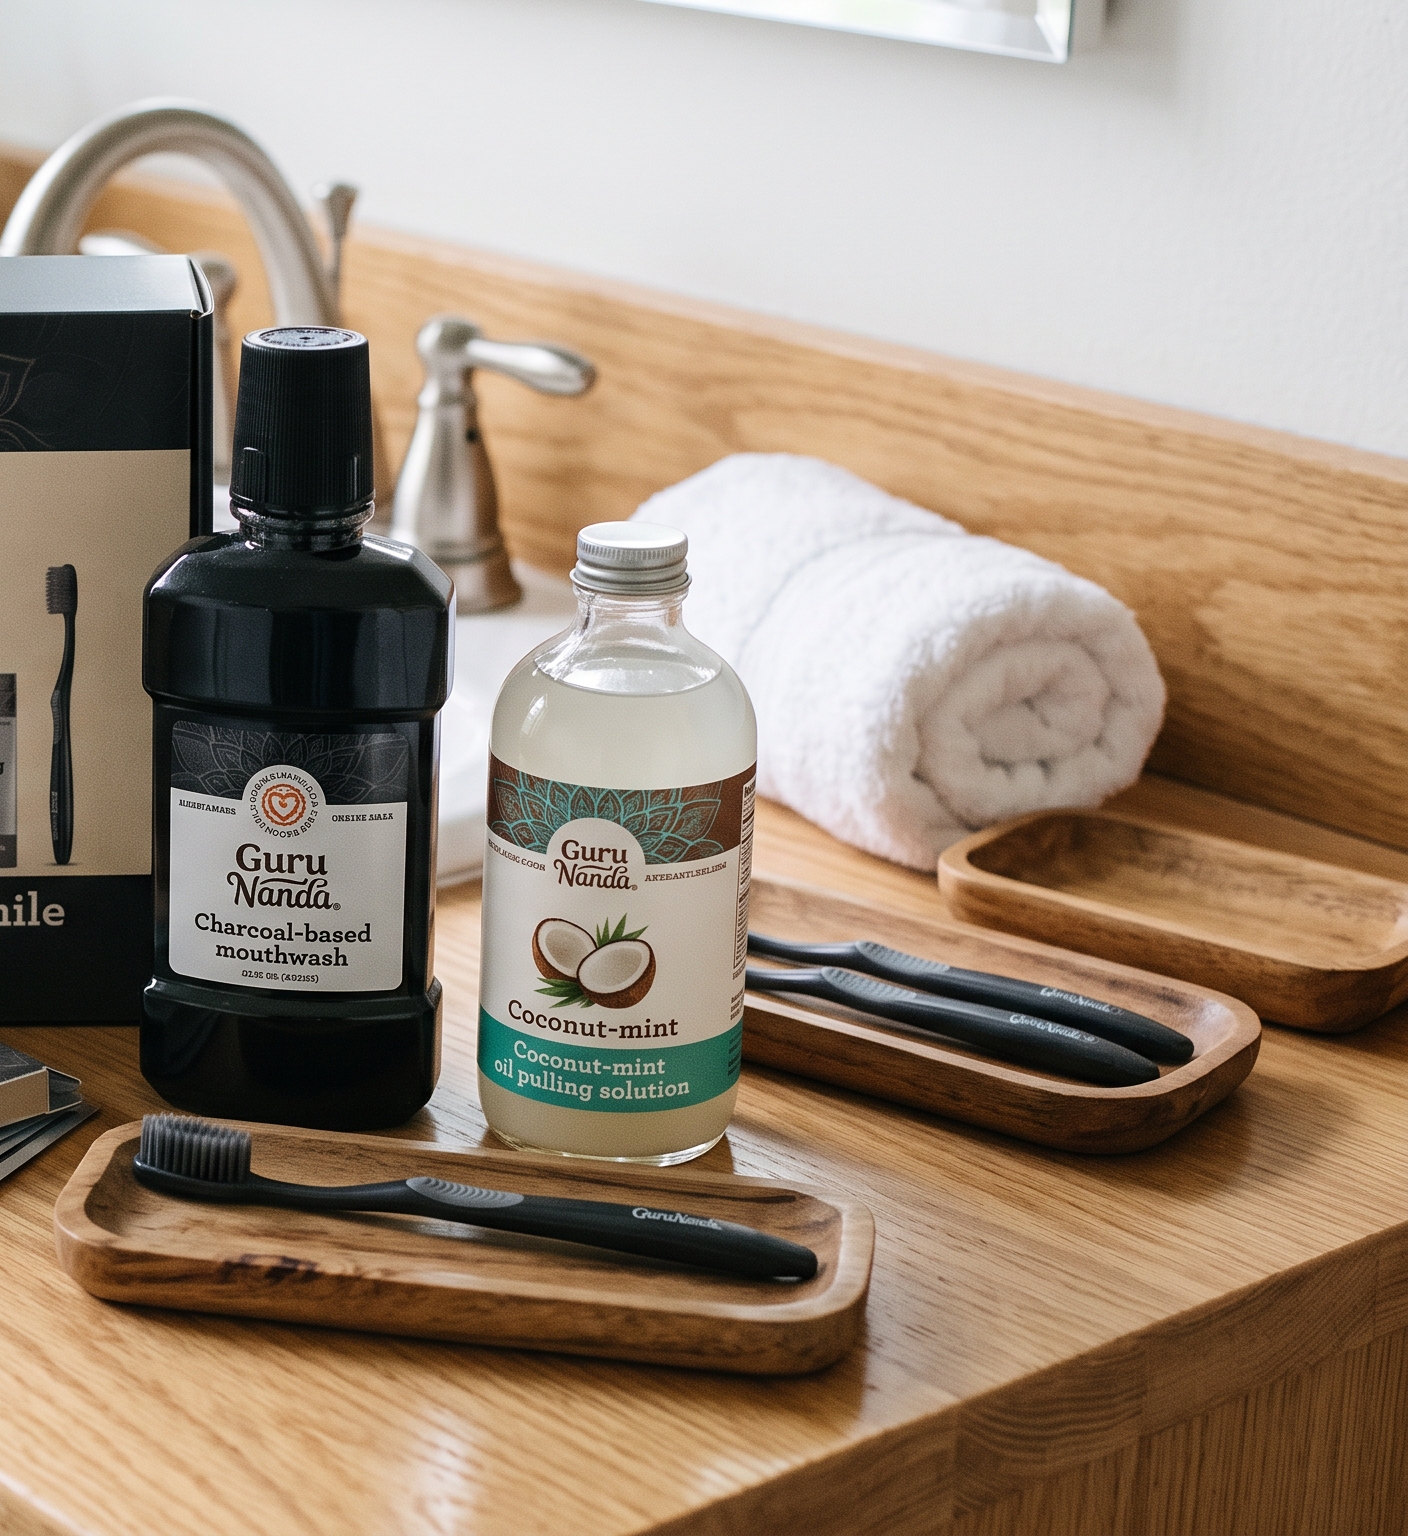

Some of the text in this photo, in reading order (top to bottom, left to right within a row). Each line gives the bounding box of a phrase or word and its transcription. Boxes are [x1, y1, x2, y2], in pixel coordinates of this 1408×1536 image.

[235, 843, 328, 875] Guru
[561, 839, 629, 864] Guru
[226, 871, 335, 910] Nanda
[553, 858, 633, 891] Nanda
[194, 912, 372, 943] Charcoal-based
[215, 944, 349, 967] mouthwash
[508, 999, 679, 1039] Coconut-mint
[513, 1040, 666, 1076] Coconut-mint
[494, 1058, 690, 1102] oil pulling solution
